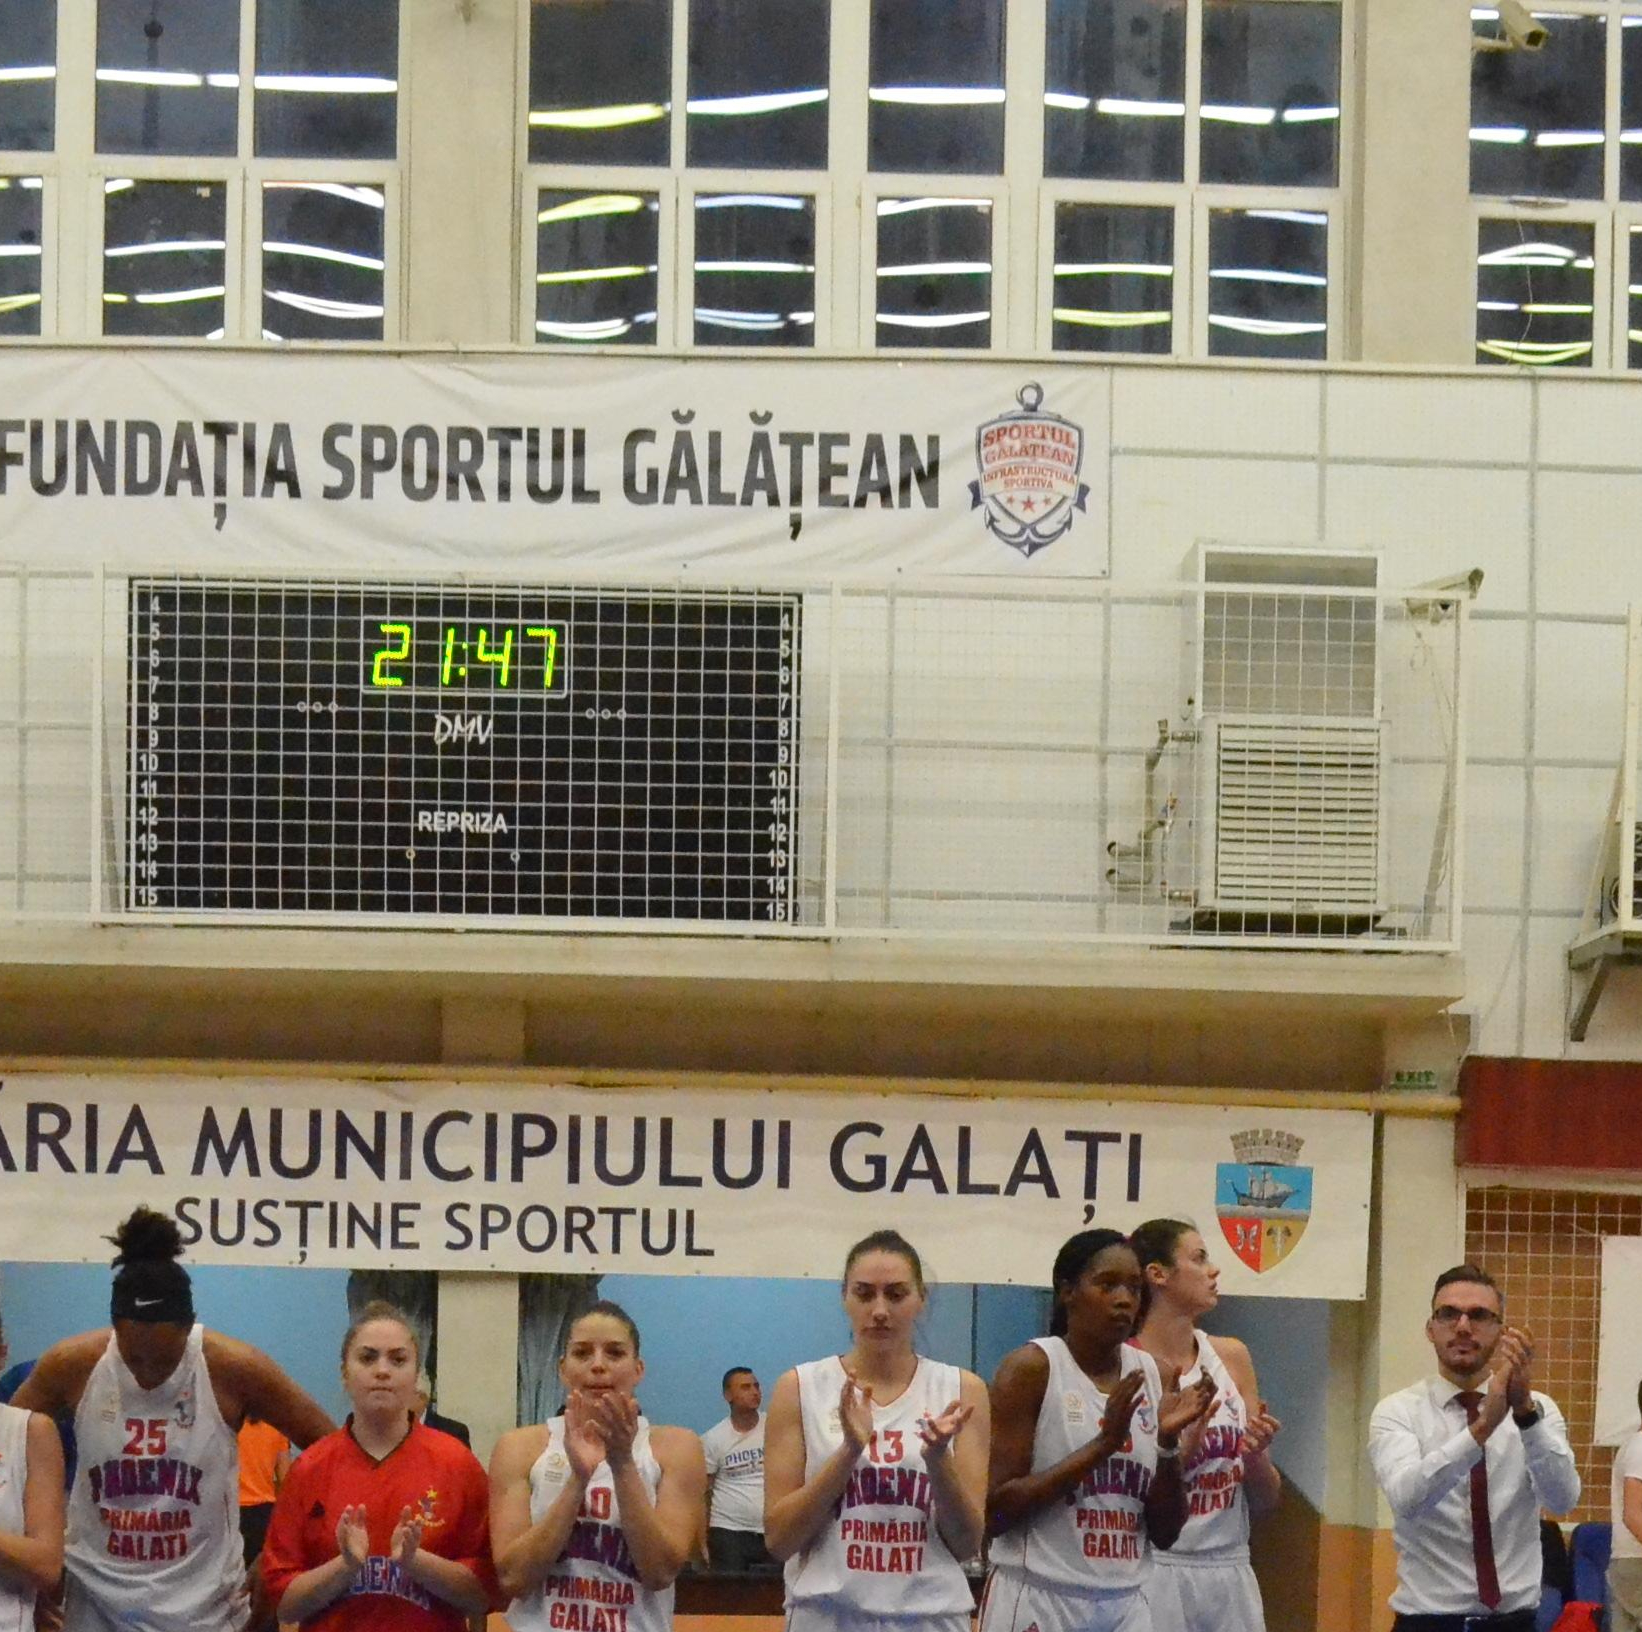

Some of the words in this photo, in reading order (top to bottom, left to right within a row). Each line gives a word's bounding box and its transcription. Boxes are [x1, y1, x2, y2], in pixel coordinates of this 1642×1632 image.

[982, 424, 1075, 449] SPORTUL
[322, 422, 601, 503] SPORTUL
[622, 408, 940, 542] GĂLĂȚEAN
[371, 623, 557, 688] 21:47
[418, 810, 509, 834] REPRIZA
[190, 1104, 792, 1191] MUNICIPIULUI
[828, 1120, 1143, 1225] GALAȚI
[444, 1200, 715, 1257] SPORTUL
[122, 1418, 168, 1456] 25
[724, 1447, 766, 1467] PHOEN
[841, 1518, 928, 1544] PRIMĂRIA
